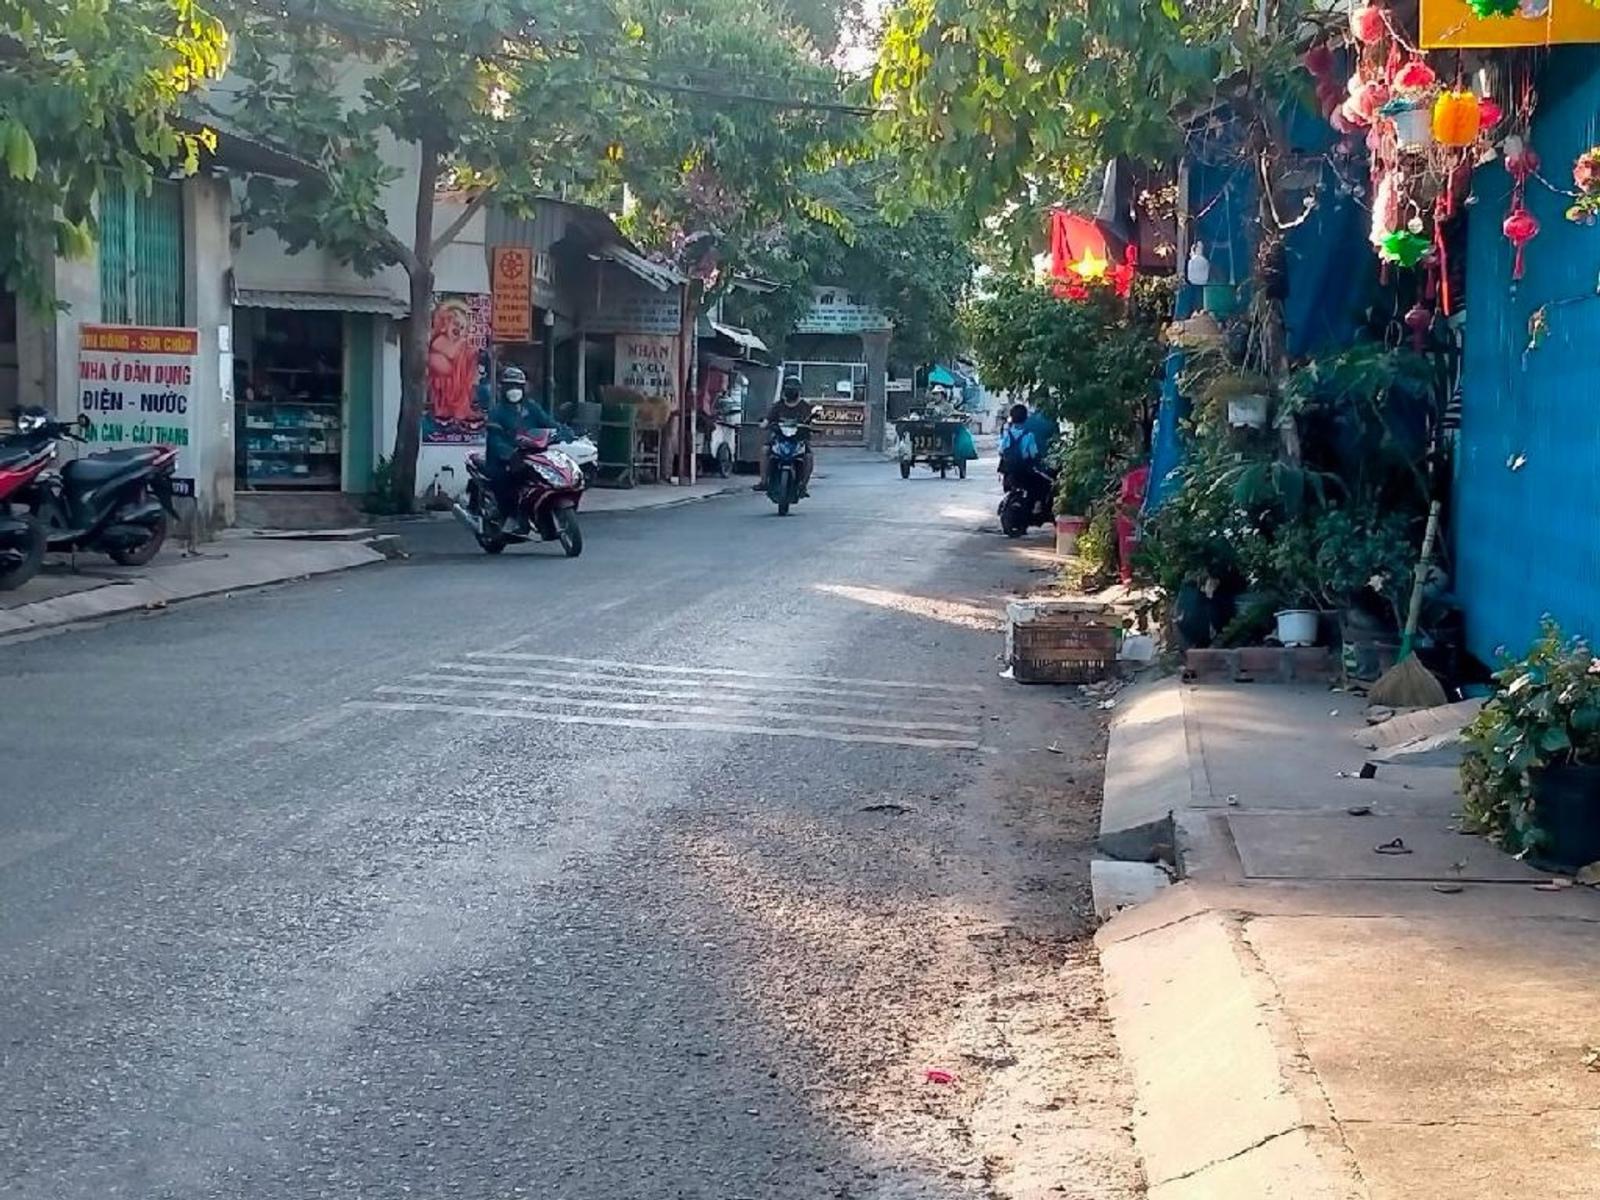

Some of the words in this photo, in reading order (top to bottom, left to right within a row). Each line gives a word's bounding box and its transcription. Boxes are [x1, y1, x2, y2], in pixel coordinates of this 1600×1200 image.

[155, 364, 191, 388] DỤNG
[83, 388, 123, 414] ĐIỆN
[140, 390, 187, 414] NƯỚC
[80, 423, 98, 442] AN
